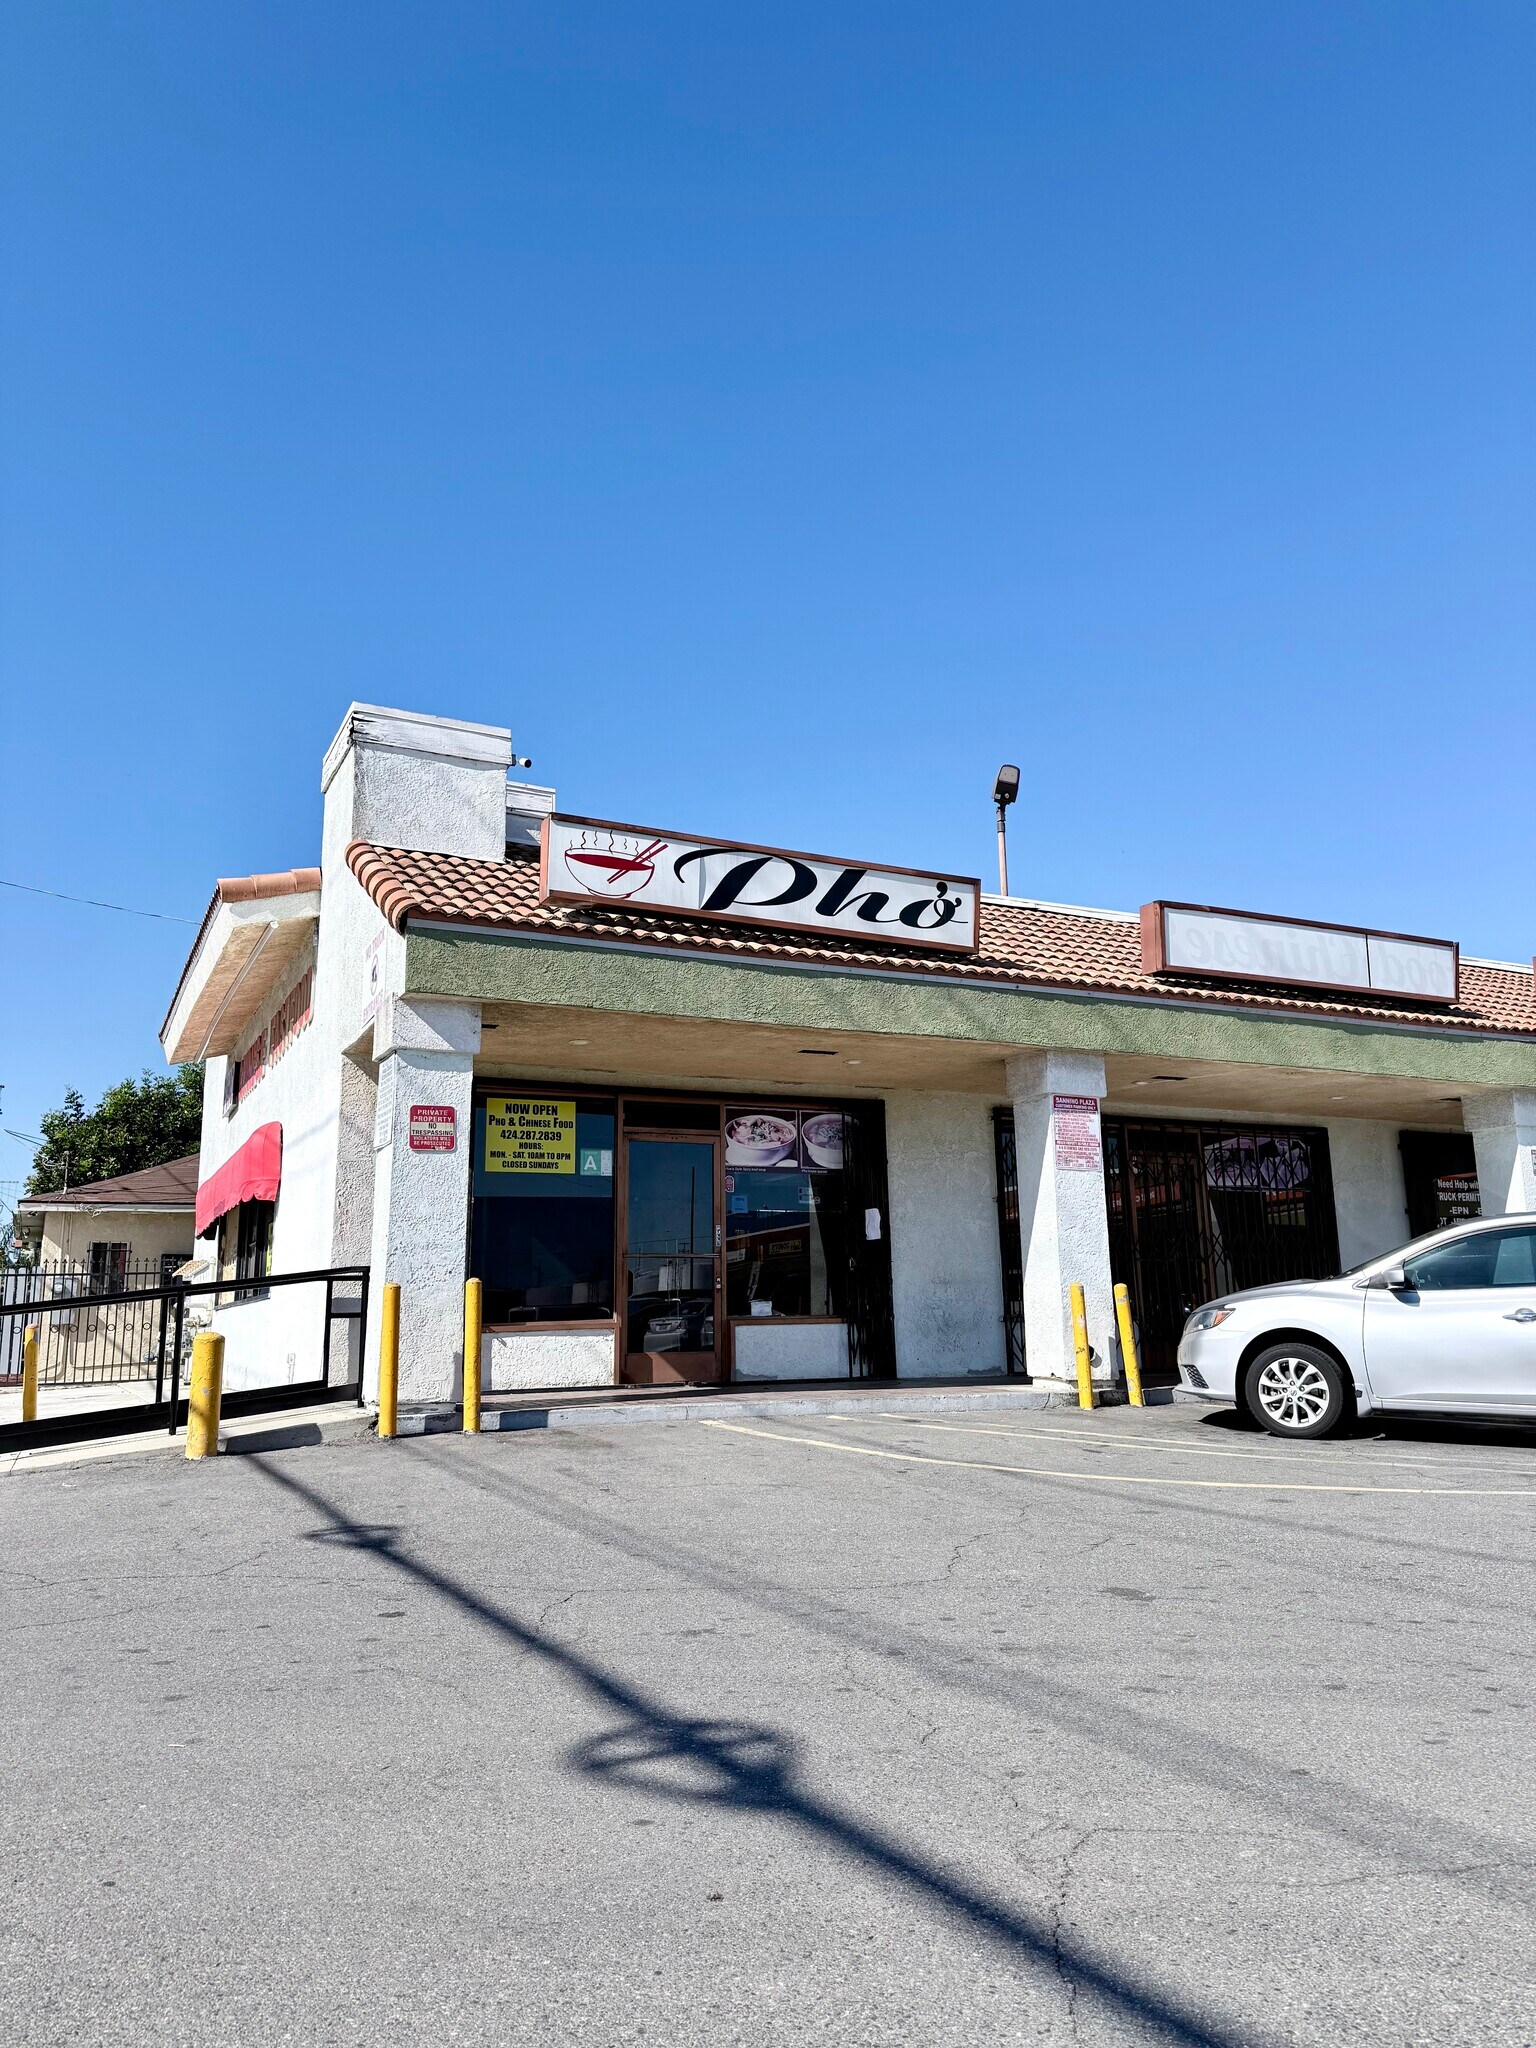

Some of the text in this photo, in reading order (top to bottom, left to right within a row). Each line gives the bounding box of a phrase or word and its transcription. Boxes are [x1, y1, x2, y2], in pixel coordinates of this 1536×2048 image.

[505, 1103, 558, 1116] NOW OPEN
[508, 1117, 516, 1127] &
[500, 1130, 562, 1141] 424.287.2839
[519, 1142, 544, 1150] HOURS:
[512, 1151, 526, 1159] SAT.
[502, 1161, 559, 1169] CLOSED SUNDAYS
[584, 1155, 597, 1170] A
[1437, 1179, 1453, 1188] Need
[1454, 1180, 1468, 1190] Help
